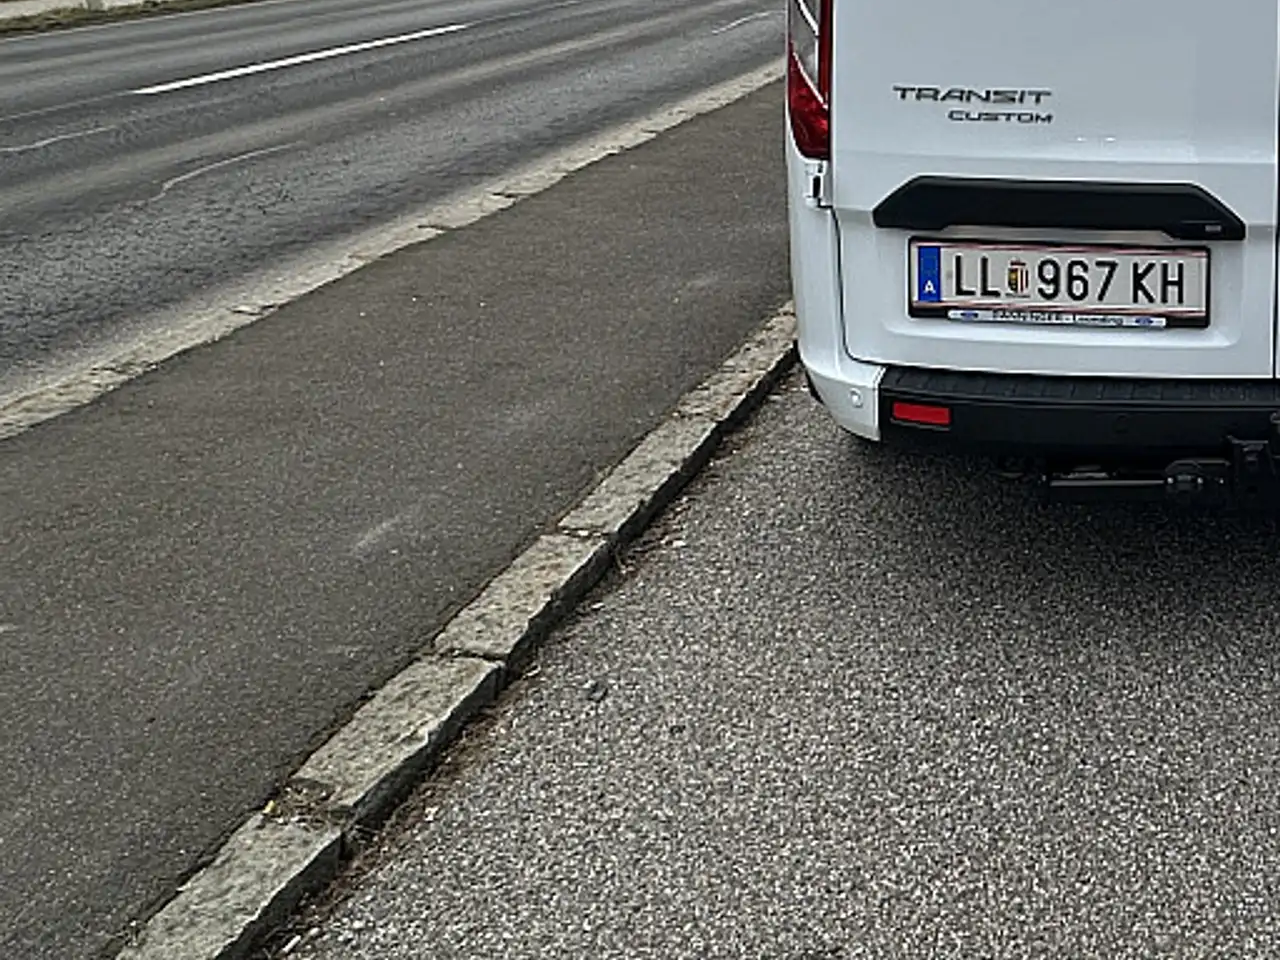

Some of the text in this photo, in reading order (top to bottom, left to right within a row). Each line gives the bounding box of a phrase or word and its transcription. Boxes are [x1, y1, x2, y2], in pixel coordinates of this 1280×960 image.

[893, 86, 1052, 105] TRANSIT
[948, 110, 1054, 124] CUSTOM
[923, 280, 937, 294] A
[955, 255, 1184, 304] LL 967 KH
